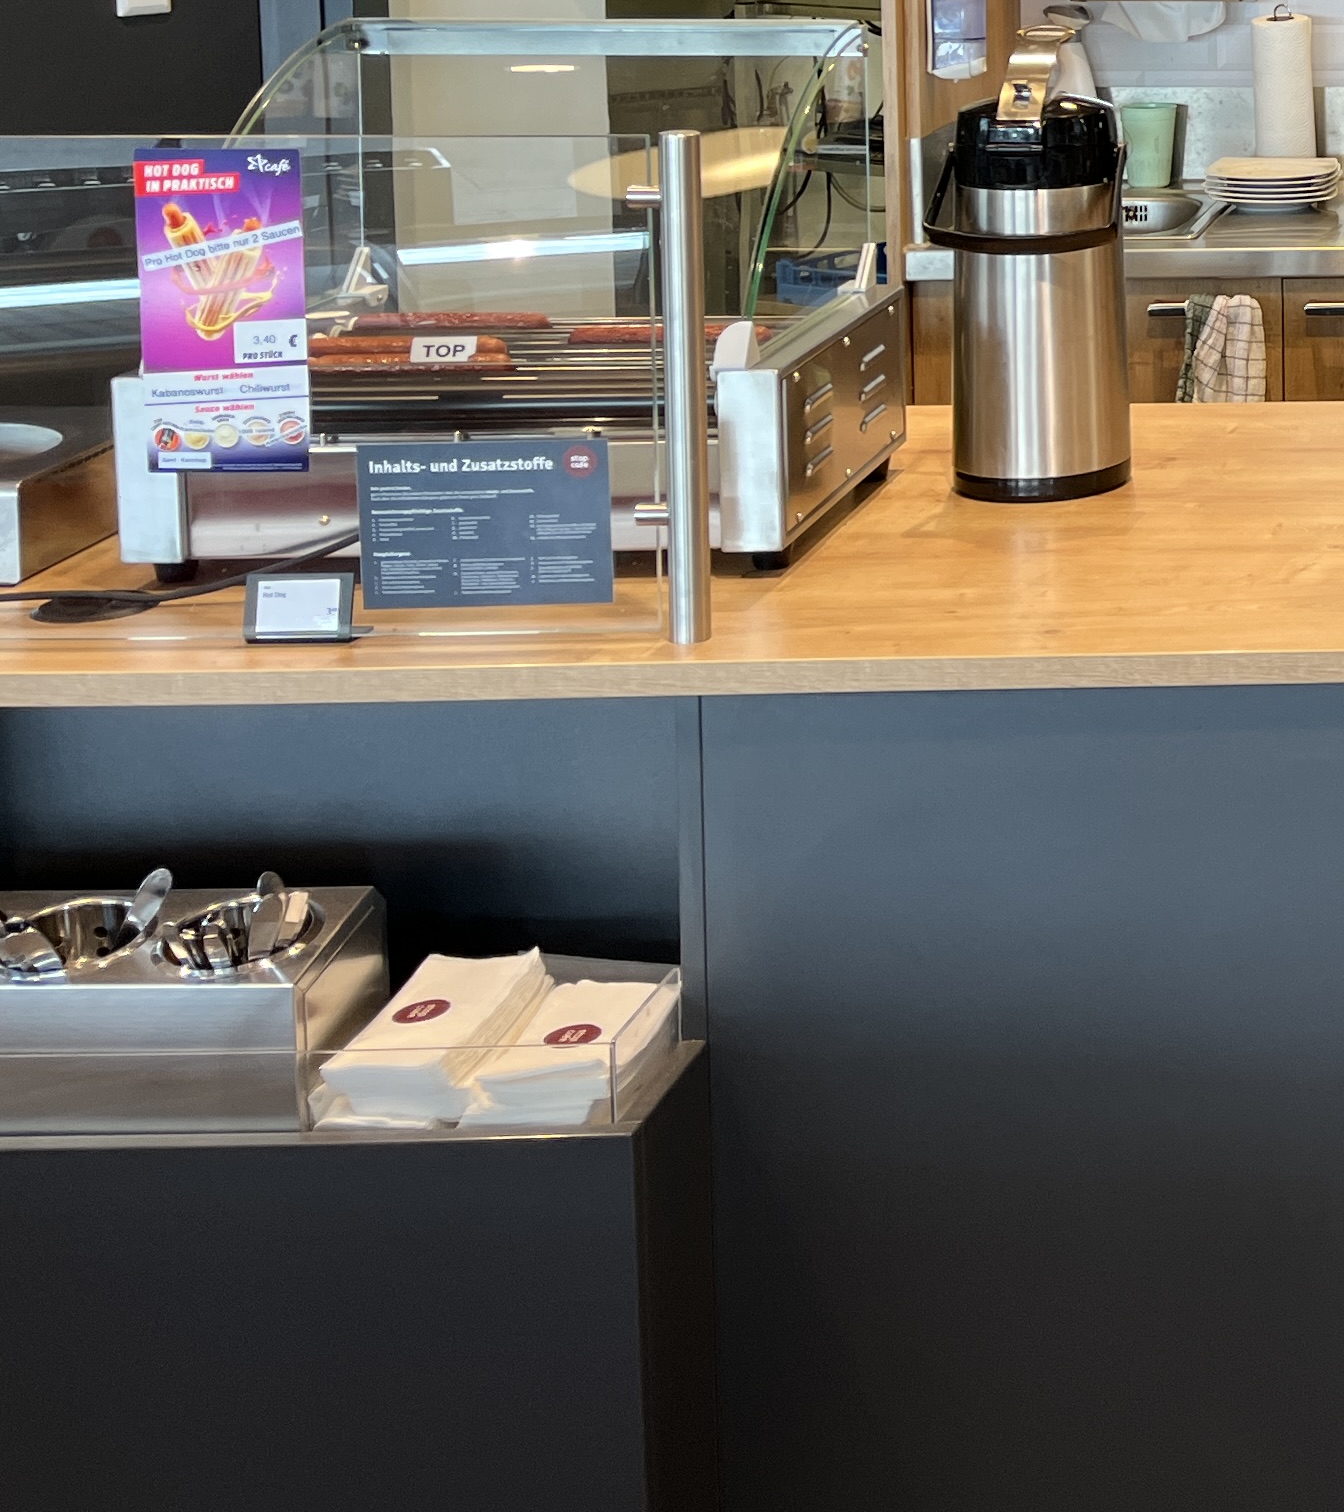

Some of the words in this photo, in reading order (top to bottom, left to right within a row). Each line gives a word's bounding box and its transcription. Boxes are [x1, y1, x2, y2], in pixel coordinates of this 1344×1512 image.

[143, 164, 170, 177] HOT
[171, 163, 199, 176] DOG
[264, 158, 291, 177] café
[145, 180, 160, 192] IN
[162, 176, 235, 192] PRAKTISCH
[144, 257, 163, 267] Pro
[165, 251, 182, 261] Hot
[185, 248, 206, 259] Dog
[208, 242, 230, 253] bitte
[233, 238, 249, 247] nur
[251, 234, 260, 243] 2
[261, 225, 300, 241] Saucen
[242, 352, 258, 360] PRO
[259, 350, 283, 359] STÜCK
[422, 344, 466, 358] TOP
[151, 387, 224, 398] Kabanoswurst
[239, 383, 290, 394] Chiliwurst
[368, 459, 427, 475] Inhalts-
[429, 461, 458, 474] und
[461, 456, 554, 473] Zusatzstoffe
